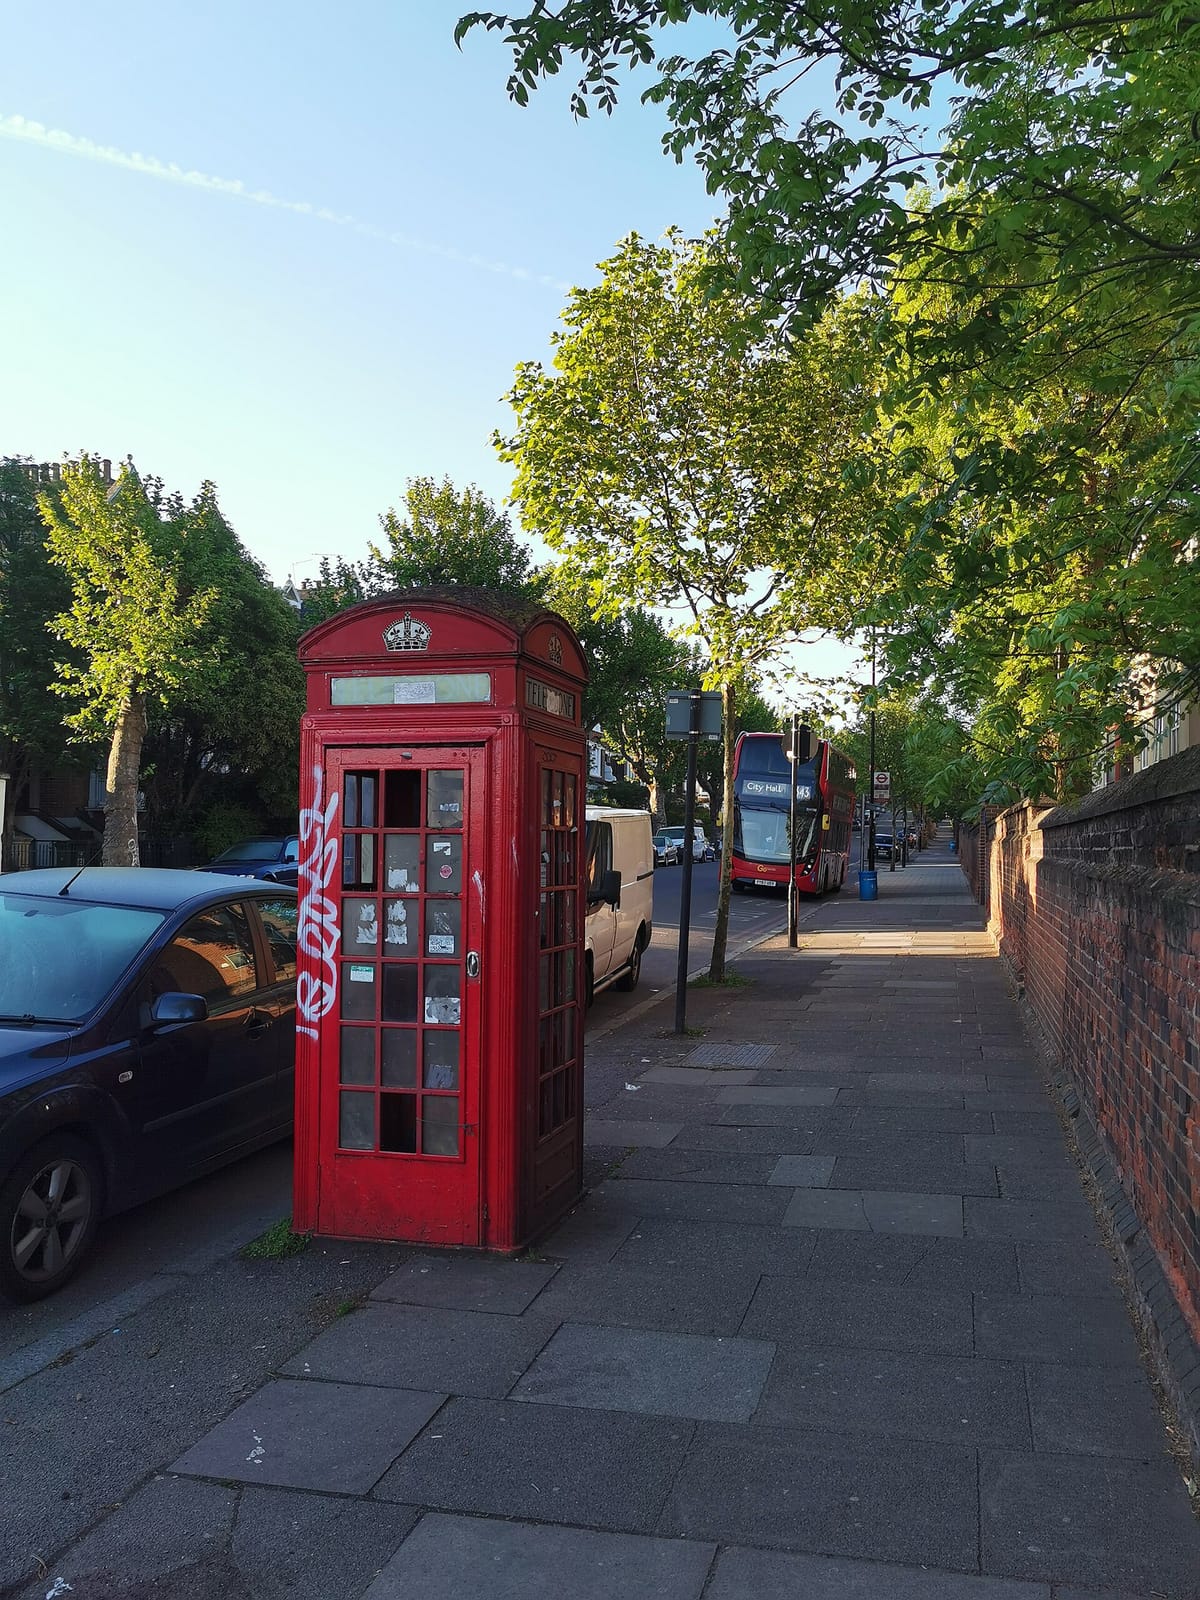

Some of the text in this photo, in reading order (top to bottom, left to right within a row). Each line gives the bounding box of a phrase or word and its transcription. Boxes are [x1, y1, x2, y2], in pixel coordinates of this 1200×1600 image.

[526, 680, 573, 717] TELEONE
[747, 782, 782, 793] City Hall
